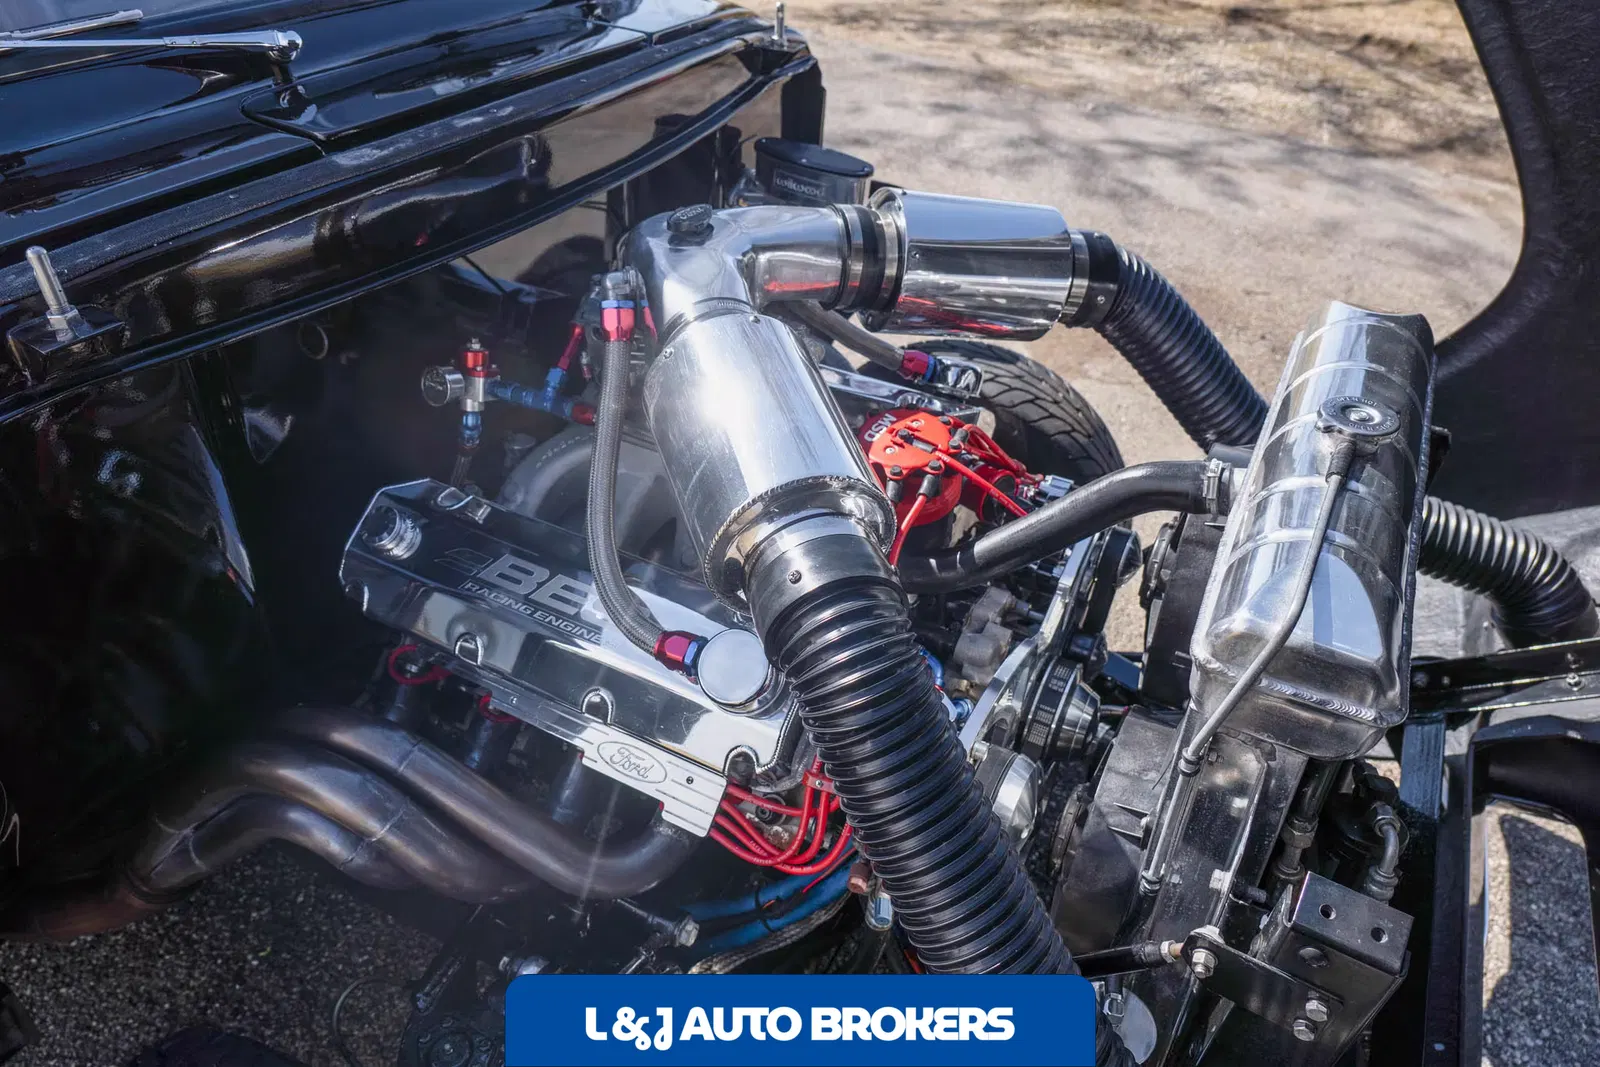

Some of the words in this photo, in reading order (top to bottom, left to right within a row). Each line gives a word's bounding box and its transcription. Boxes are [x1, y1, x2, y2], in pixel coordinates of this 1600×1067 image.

[863, 412, 898, 442] MSD
[461, 581, 535, 616] RACING
[609, 746, 655, 780] Ford
